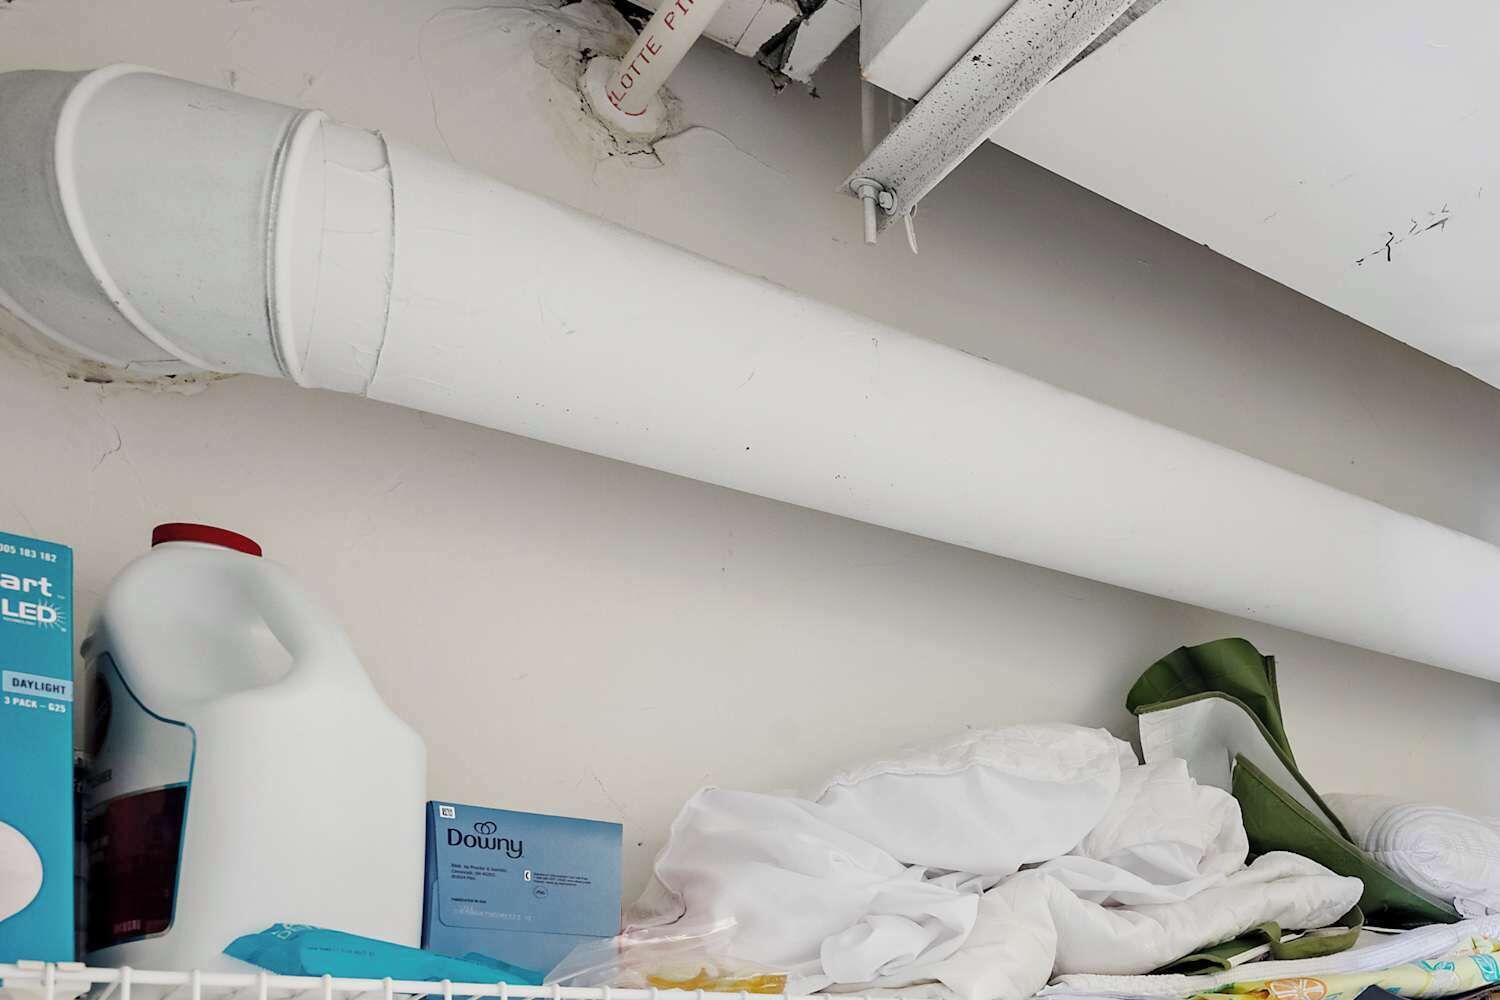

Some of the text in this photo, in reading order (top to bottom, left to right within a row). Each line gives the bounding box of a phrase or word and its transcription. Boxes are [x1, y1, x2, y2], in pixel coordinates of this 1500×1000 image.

[20, 547, 37, 558] 183
[40, 553, 57, 563] 182
[2, 598, 57, 624] LED
[12, 677, 67, 695] DAYLIGHT
[12, 697, 38, 709] PACK
[447, 828, 524, 860] Downy
